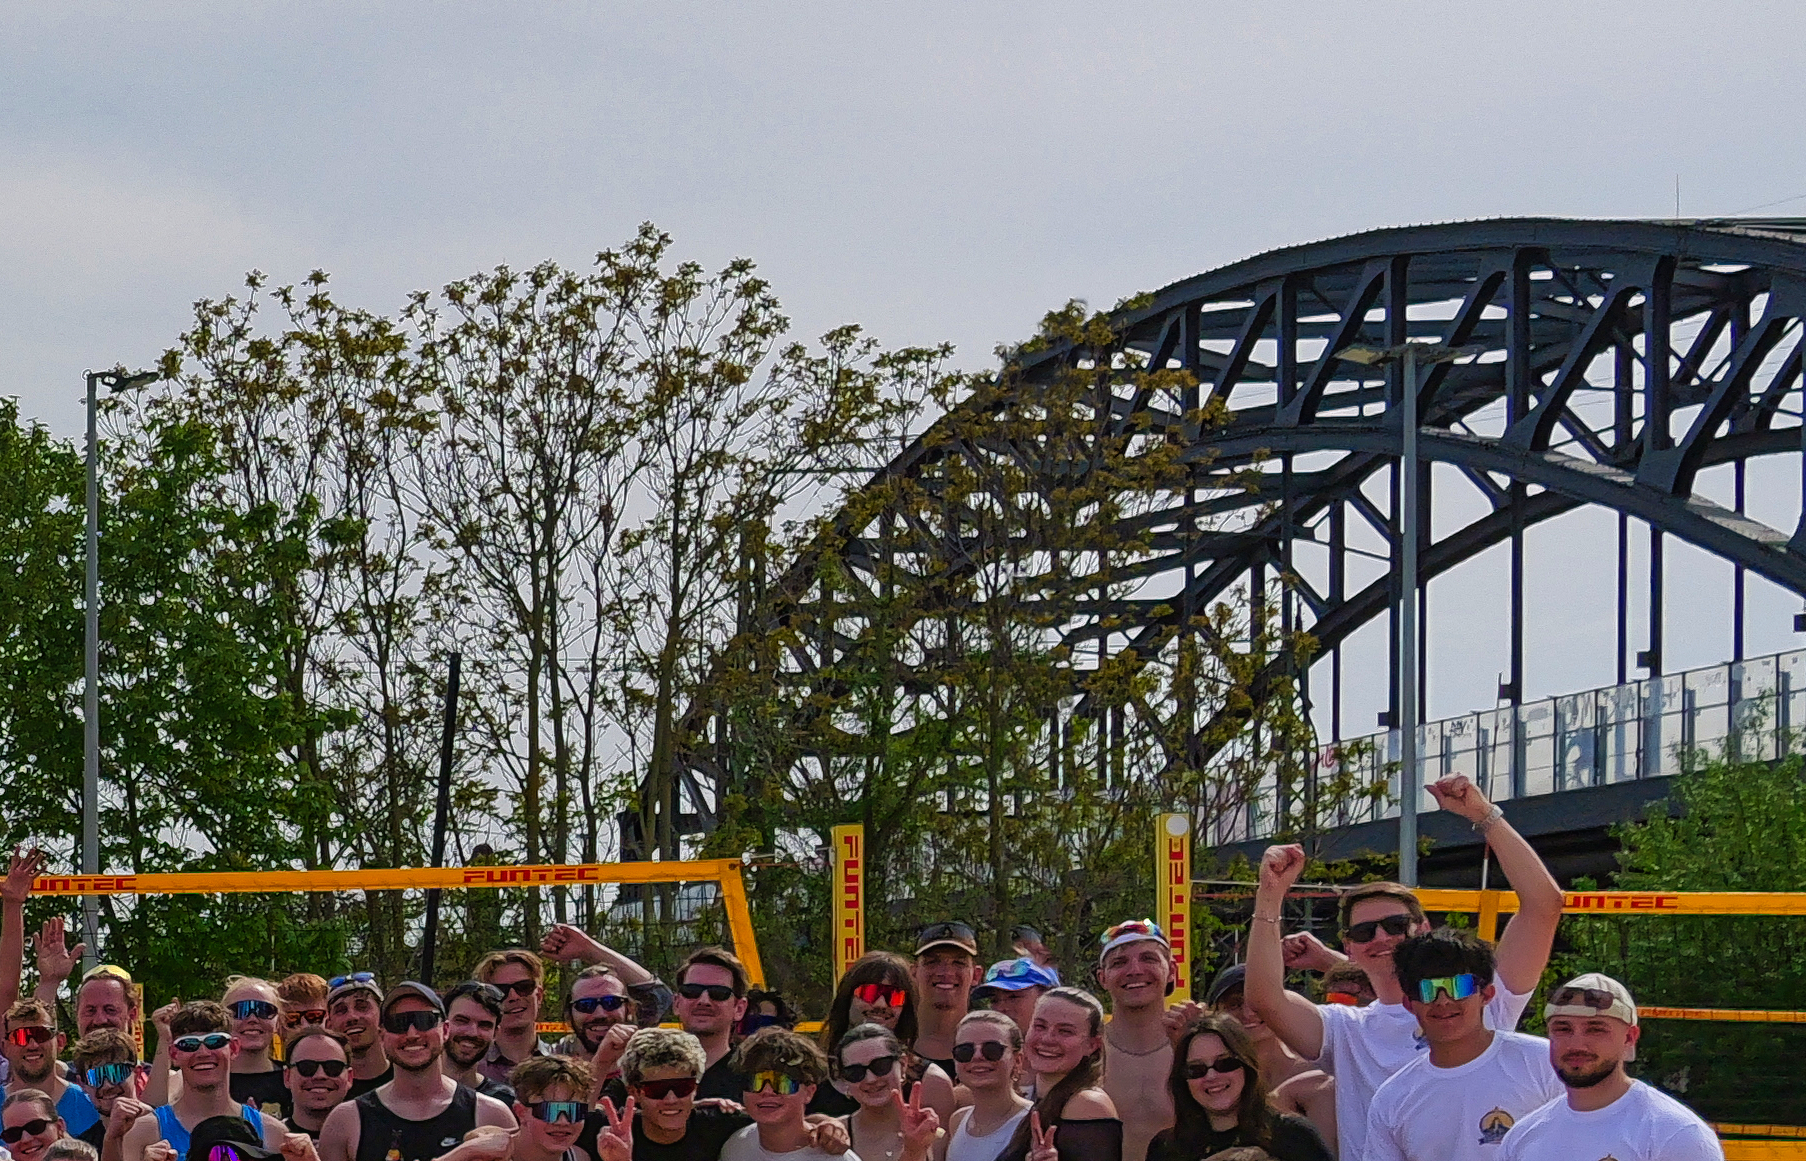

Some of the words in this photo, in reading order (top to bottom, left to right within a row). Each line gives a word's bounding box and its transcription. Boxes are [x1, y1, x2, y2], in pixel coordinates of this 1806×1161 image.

[464, 867, 599, 883] FUNTEC
[30, 878, 137, 891] UNTEC
[1562, 895, 1678, 909] UNTEC
